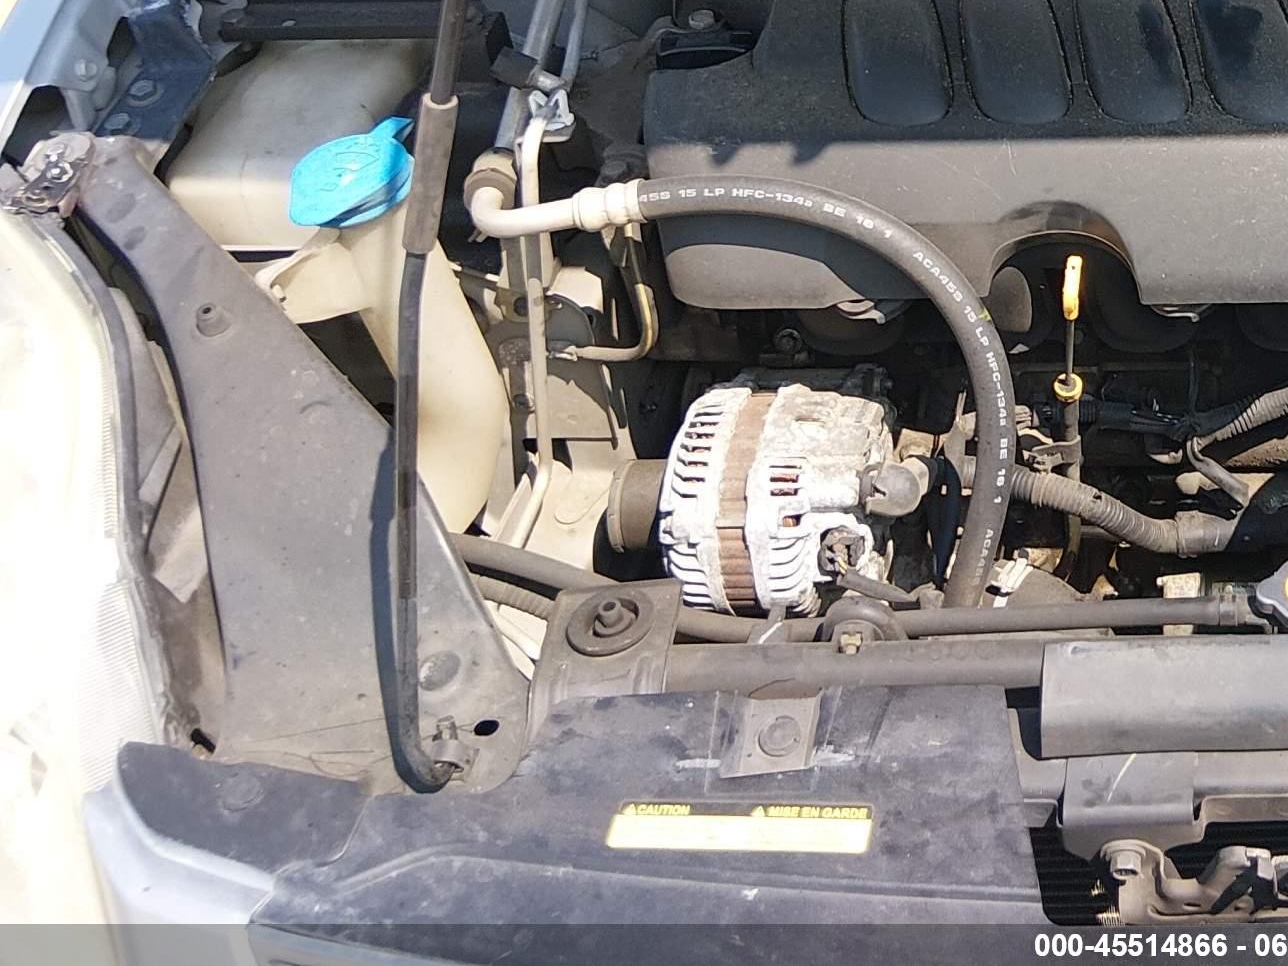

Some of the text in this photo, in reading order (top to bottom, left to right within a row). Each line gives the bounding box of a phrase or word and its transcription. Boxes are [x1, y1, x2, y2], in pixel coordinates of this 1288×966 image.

[678, 188, 697, 198] 15
[704, 187, 725, 197] LP
[732, 187, 813, 208] HFC-134a
[912, 251, 964, 303] ACA45S
[963, 305, 979, 323] 15
[975, 326, 991, 347] LP
[985, 351, 1008, 426] HFC-134a
[636, 804, 691, 816] CAUTION
[767, 806, 868, 819] MISE EN GARDE
